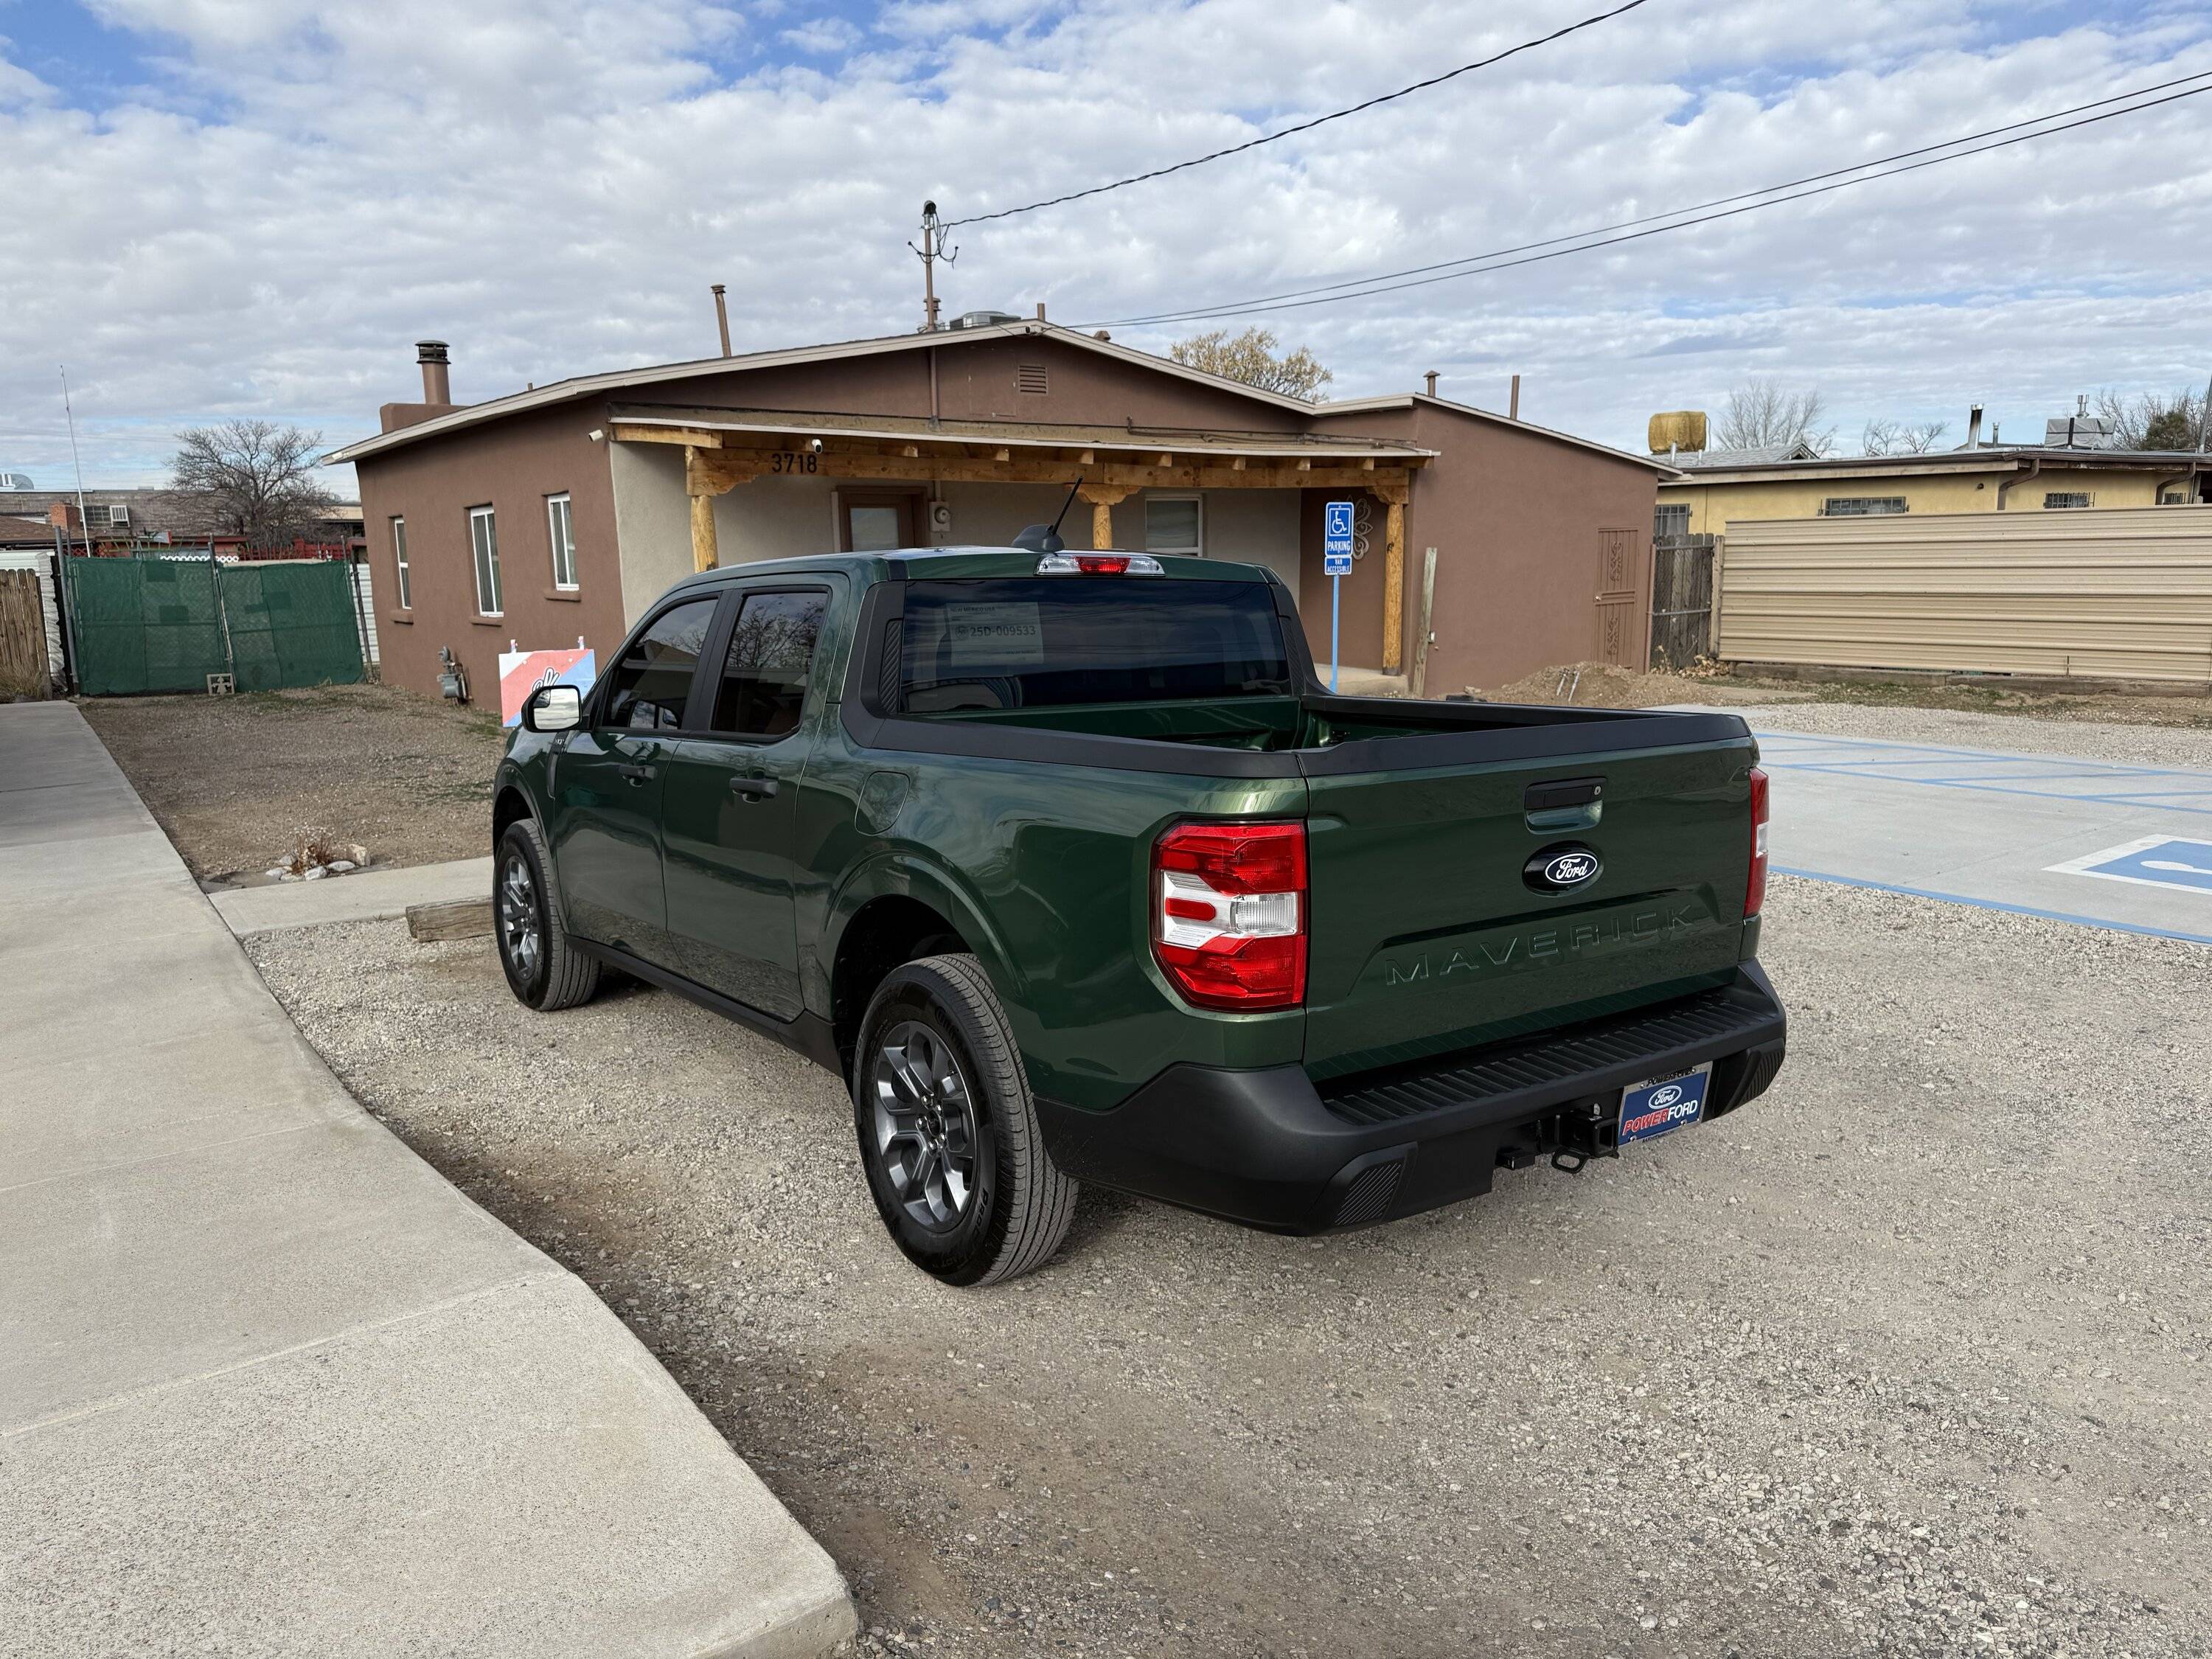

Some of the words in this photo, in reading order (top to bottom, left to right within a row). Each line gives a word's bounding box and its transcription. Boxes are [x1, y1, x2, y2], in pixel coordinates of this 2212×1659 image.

[771, 453, 817, 473] 3718
[1327, 540, 1351, 552] PARKING
[970, 625, 1036, 637] 25D-009533
[1556, 858, 1588, 880] Ford
[1385, 904, 1695, 986] MAVERICK
[1655, 1090, 1676, 1105] Ford
[1622, 1099, 1698, 1136] POWERFORD
